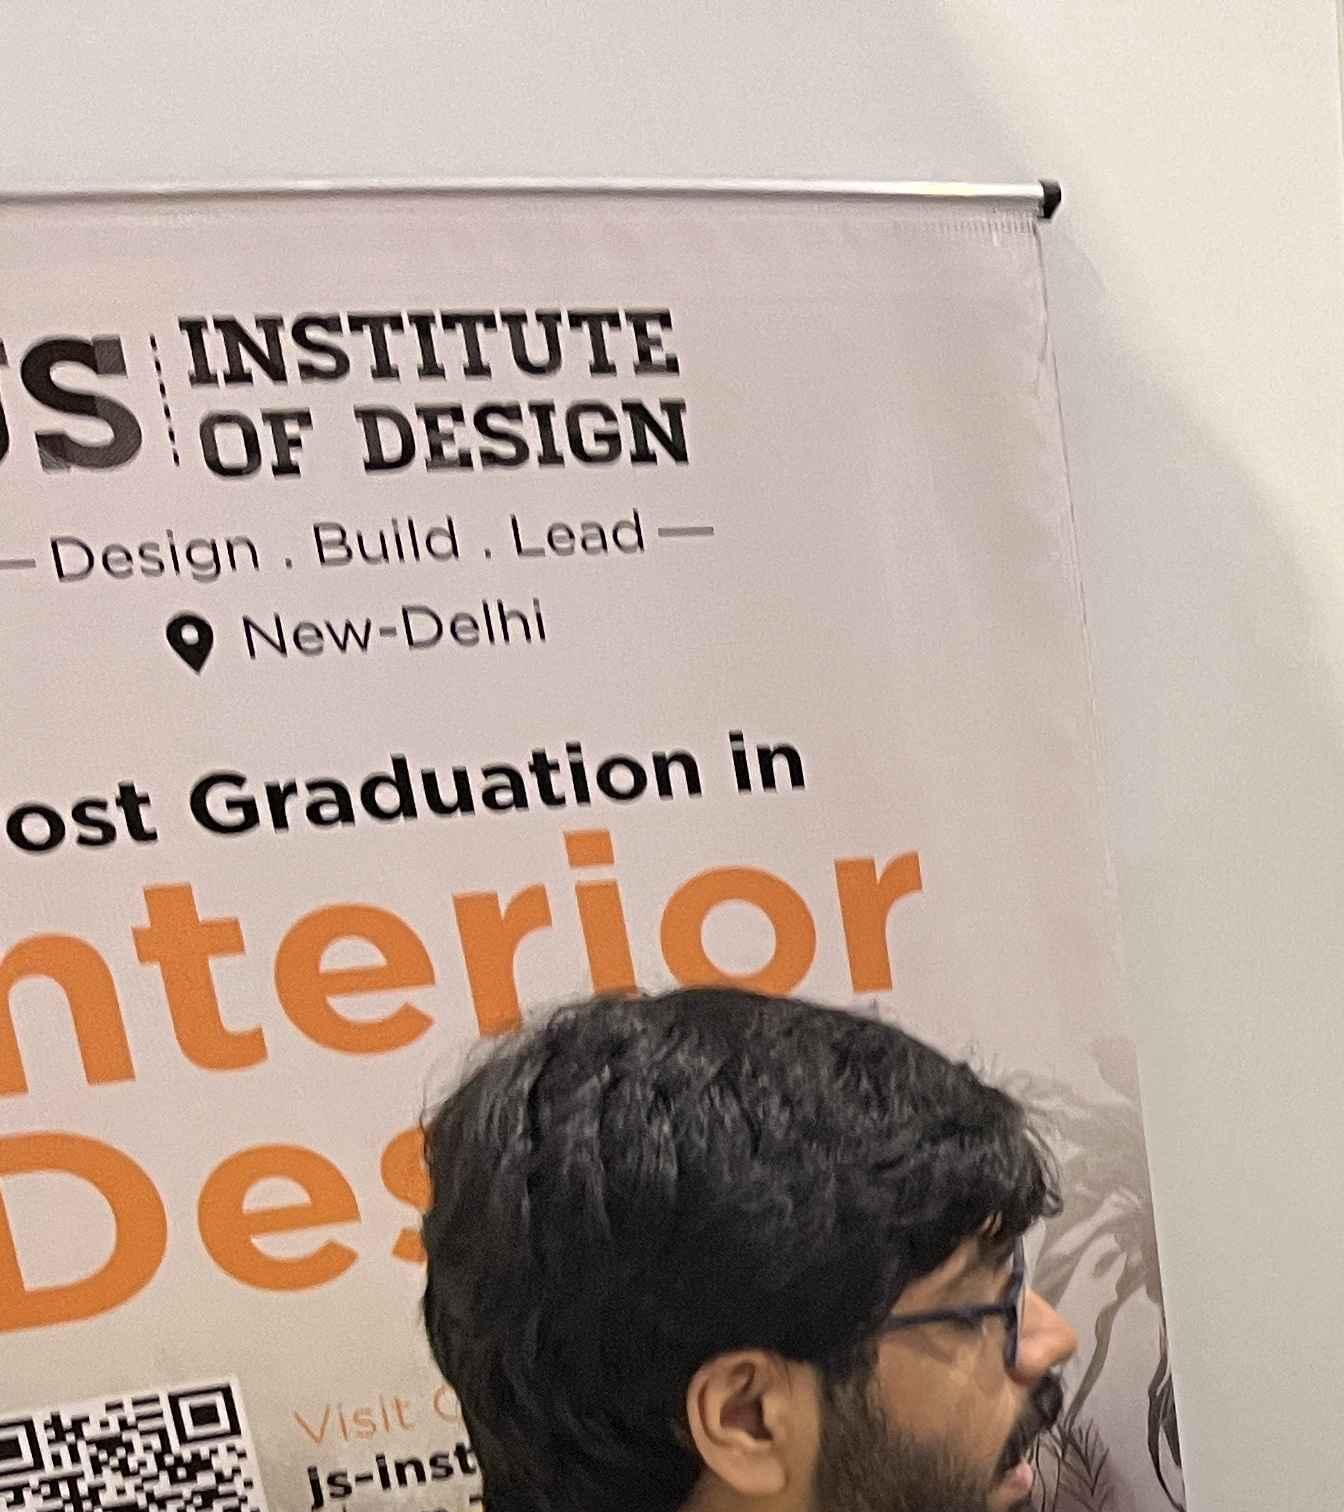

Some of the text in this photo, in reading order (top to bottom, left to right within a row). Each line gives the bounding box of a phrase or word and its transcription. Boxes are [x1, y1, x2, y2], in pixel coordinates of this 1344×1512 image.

[178, 307, 680, 389] INSTITUTE
[0, 334, 142, 474] S
[199, 397, 689, 481] OF DESIGN
[50, 529, 259, 584] Design
[313, 514, 459, 568] Build
[510, 508, 645, 558] Lead
[242, 597, 546, 660] New-Delhi
[190, 741, 702, 845] Graduation
[728, 728, 805, 795] in
[295, 1394, 417, 1444] Visit
